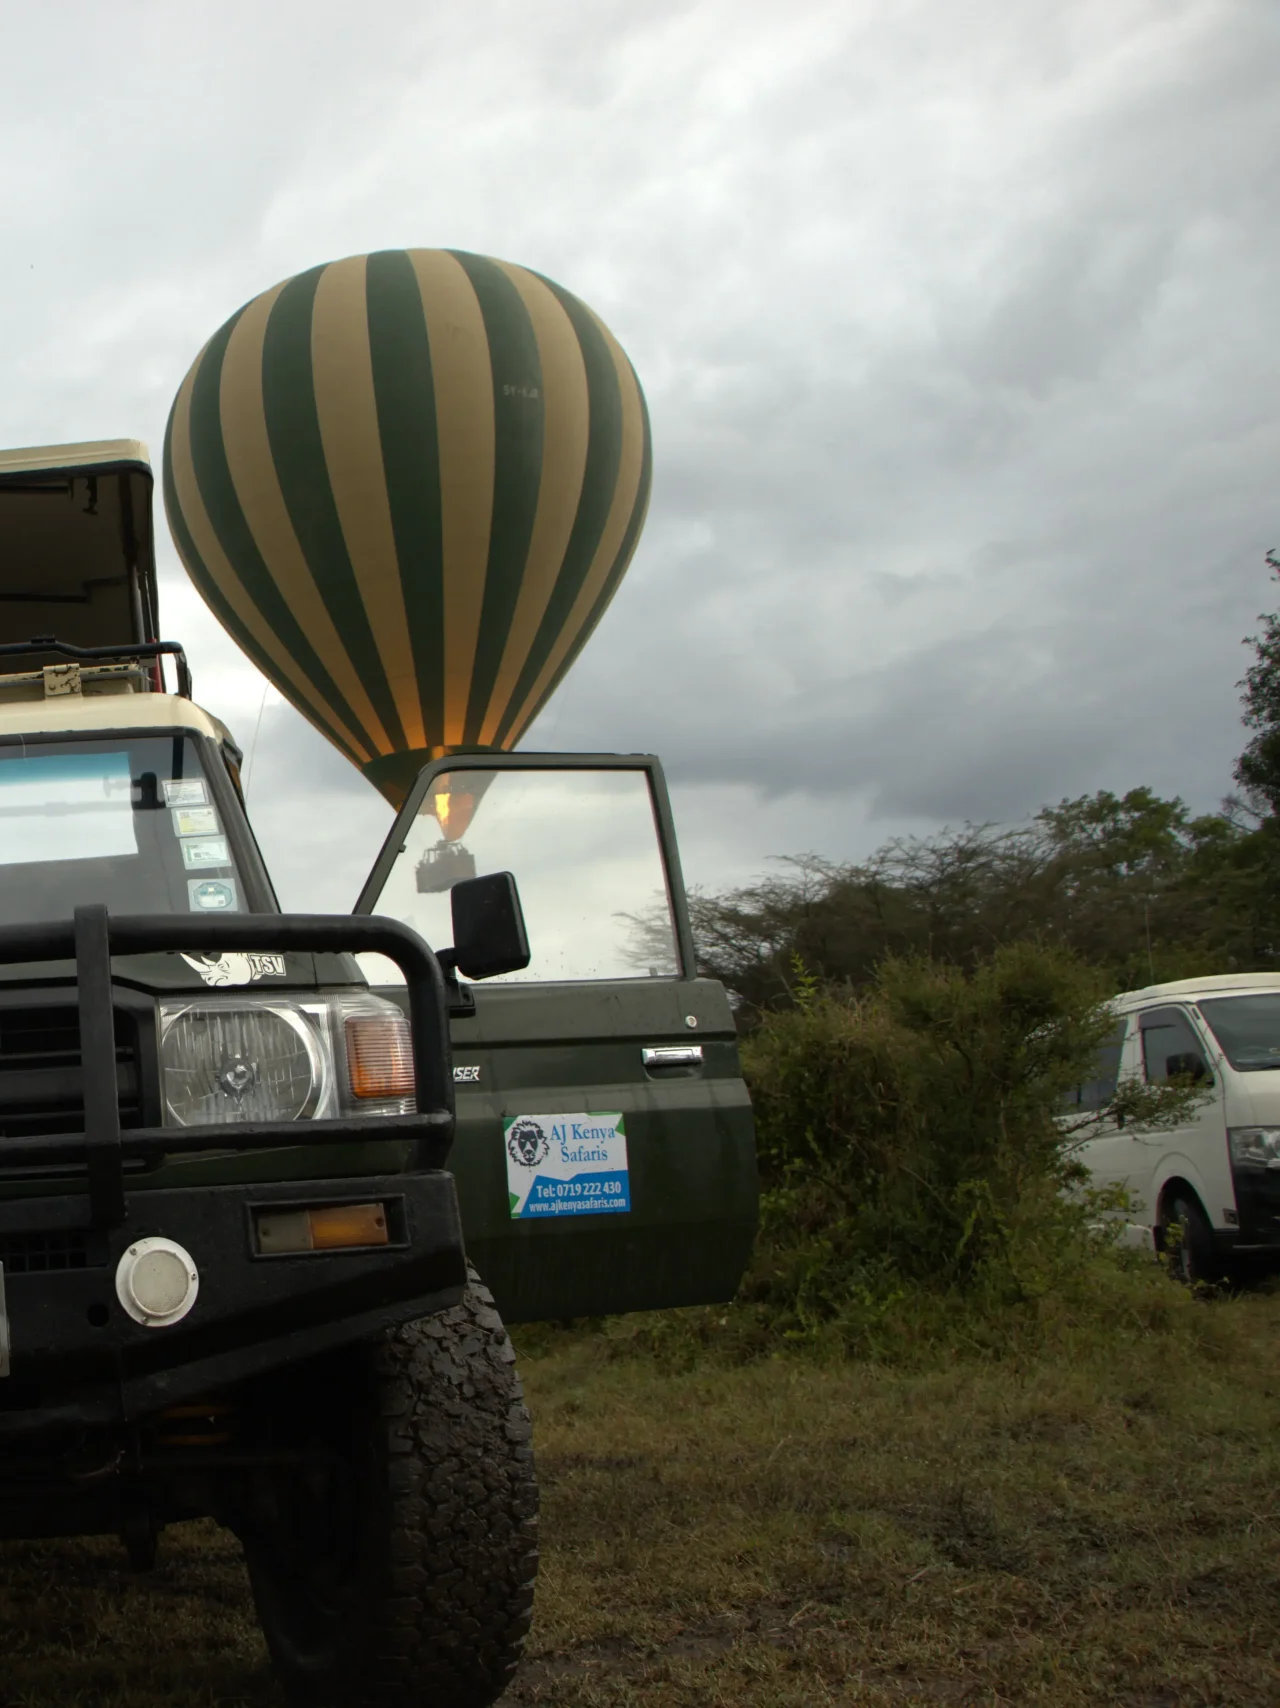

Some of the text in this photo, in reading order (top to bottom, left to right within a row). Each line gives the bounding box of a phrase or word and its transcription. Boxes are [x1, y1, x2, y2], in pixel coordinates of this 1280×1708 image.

[251, 956, 284, 973] TSV
[550, 1123, 615, 1145] AJ Kenya
[561, 1145, 608, 1163] Safaris
[536, 1181, 621, 1198] Tel: 0719 222 430
[529, 1197, 626, 1213] www.ajkenyasafaris.com
